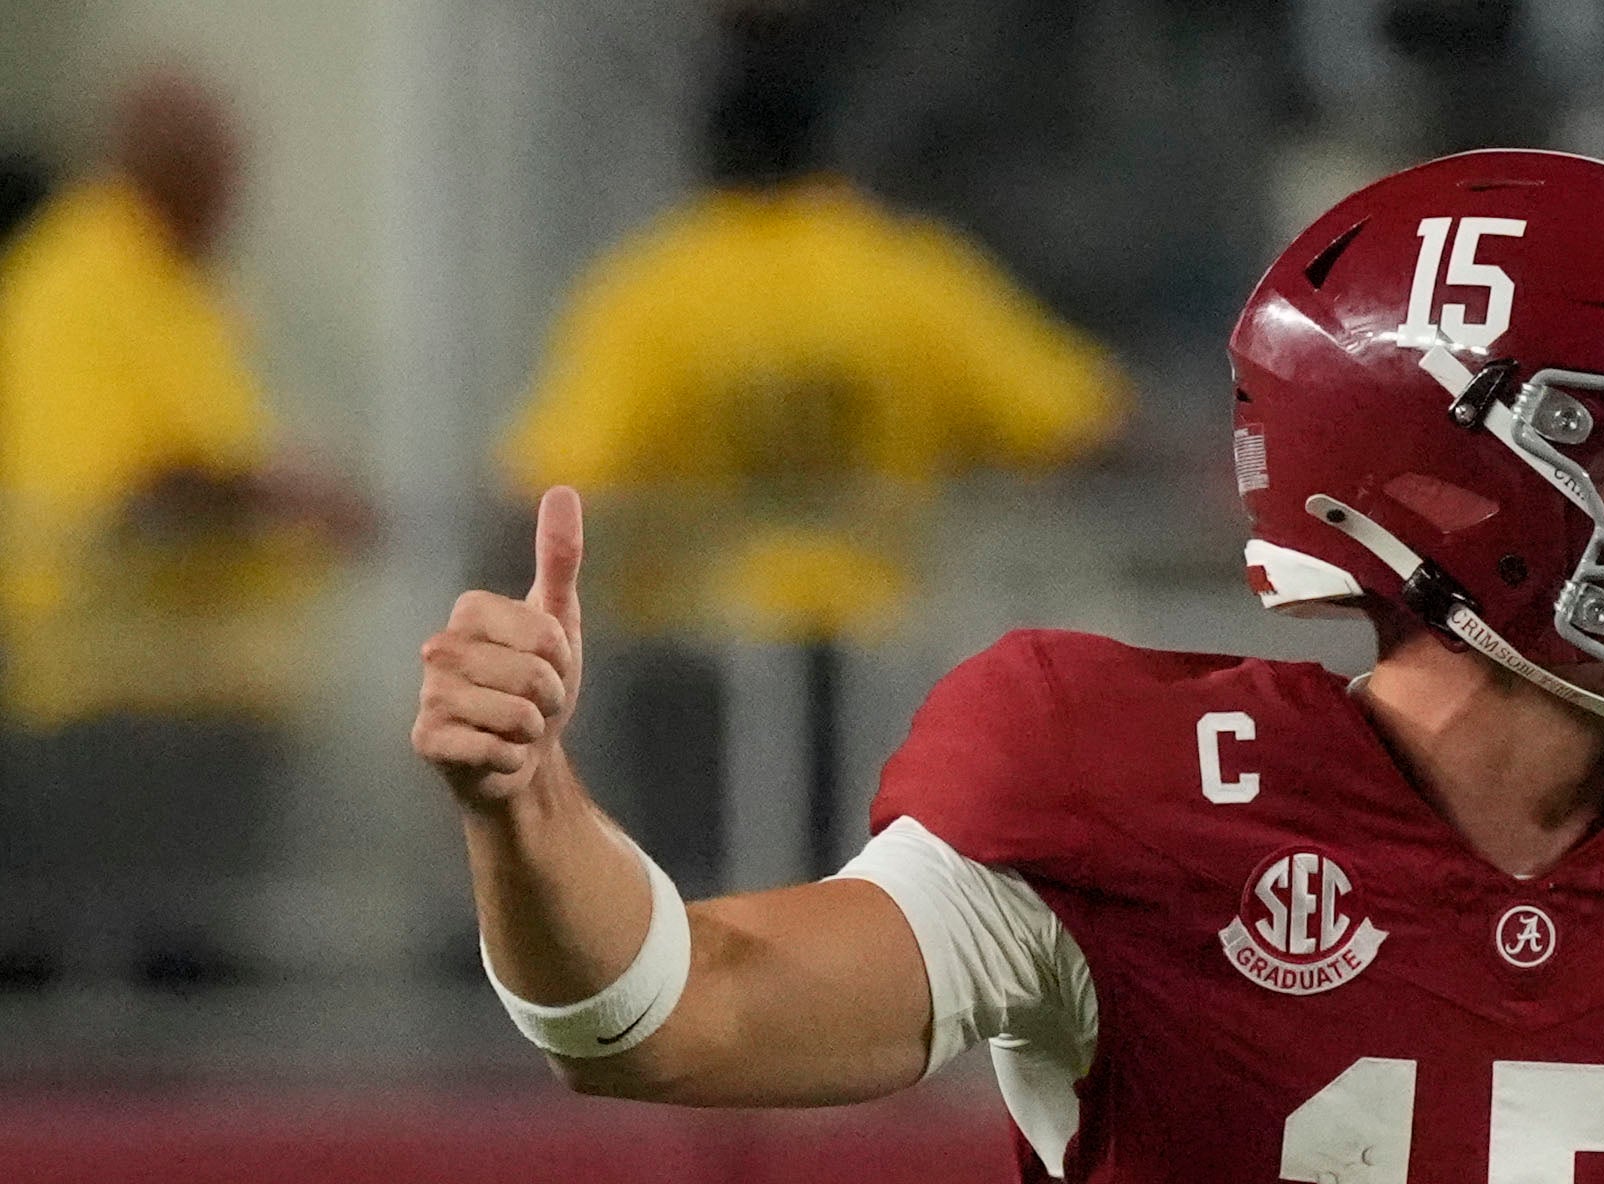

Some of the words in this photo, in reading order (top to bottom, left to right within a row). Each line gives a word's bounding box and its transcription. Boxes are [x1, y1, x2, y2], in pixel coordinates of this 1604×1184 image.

[1396, 216, 1528, 348] 15
[1196, 711, 1260, 804] C
[1254, 852, 1352, 955] SEC
[1236, 944, 1362, 991] GRADUATE
